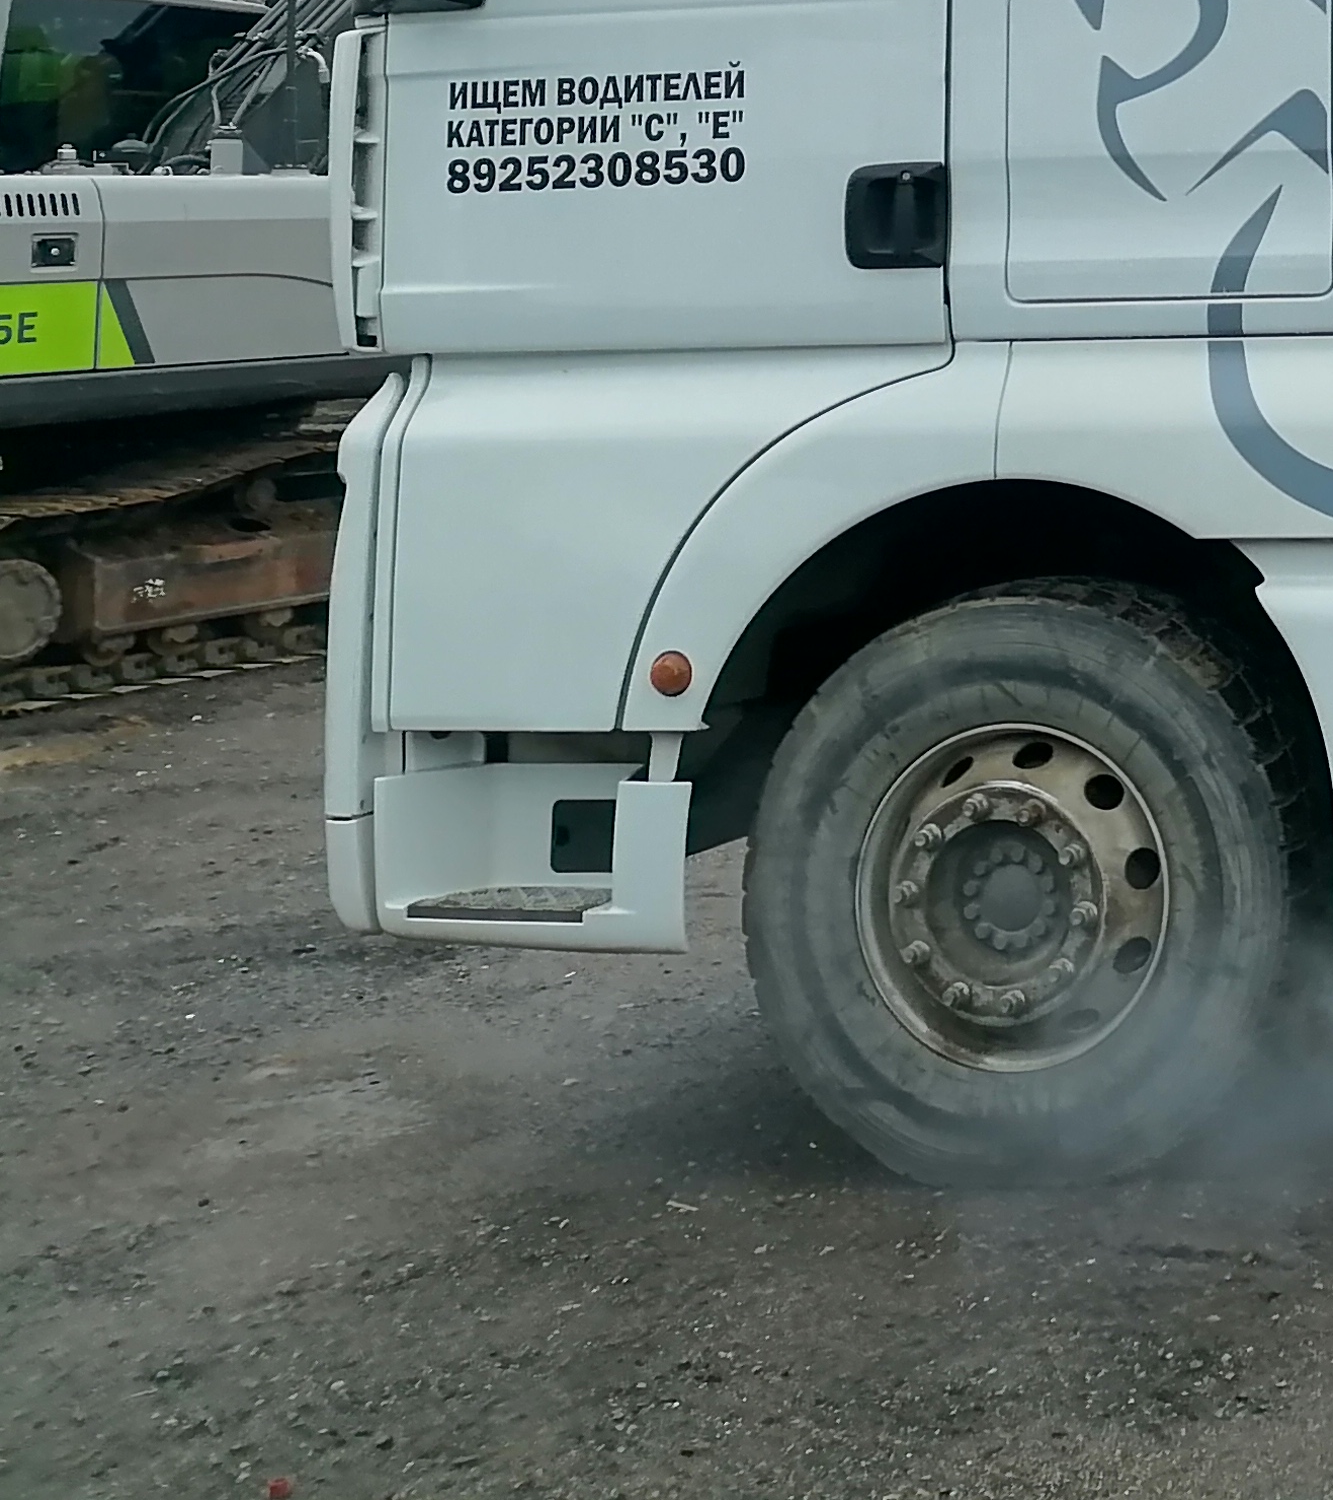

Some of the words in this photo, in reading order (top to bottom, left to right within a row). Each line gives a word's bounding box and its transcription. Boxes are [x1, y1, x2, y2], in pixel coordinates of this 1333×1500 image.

[449, 78, 547, 115] ИЩЕМ
[556, 60, 746, 111] ВОДИТЕЛЕЙ
[446, 114, 621, 149] КАТЕГОРИИ
[697, 110, 745, 140] "Е"
[446, 146, 746, 194] 89252308530
